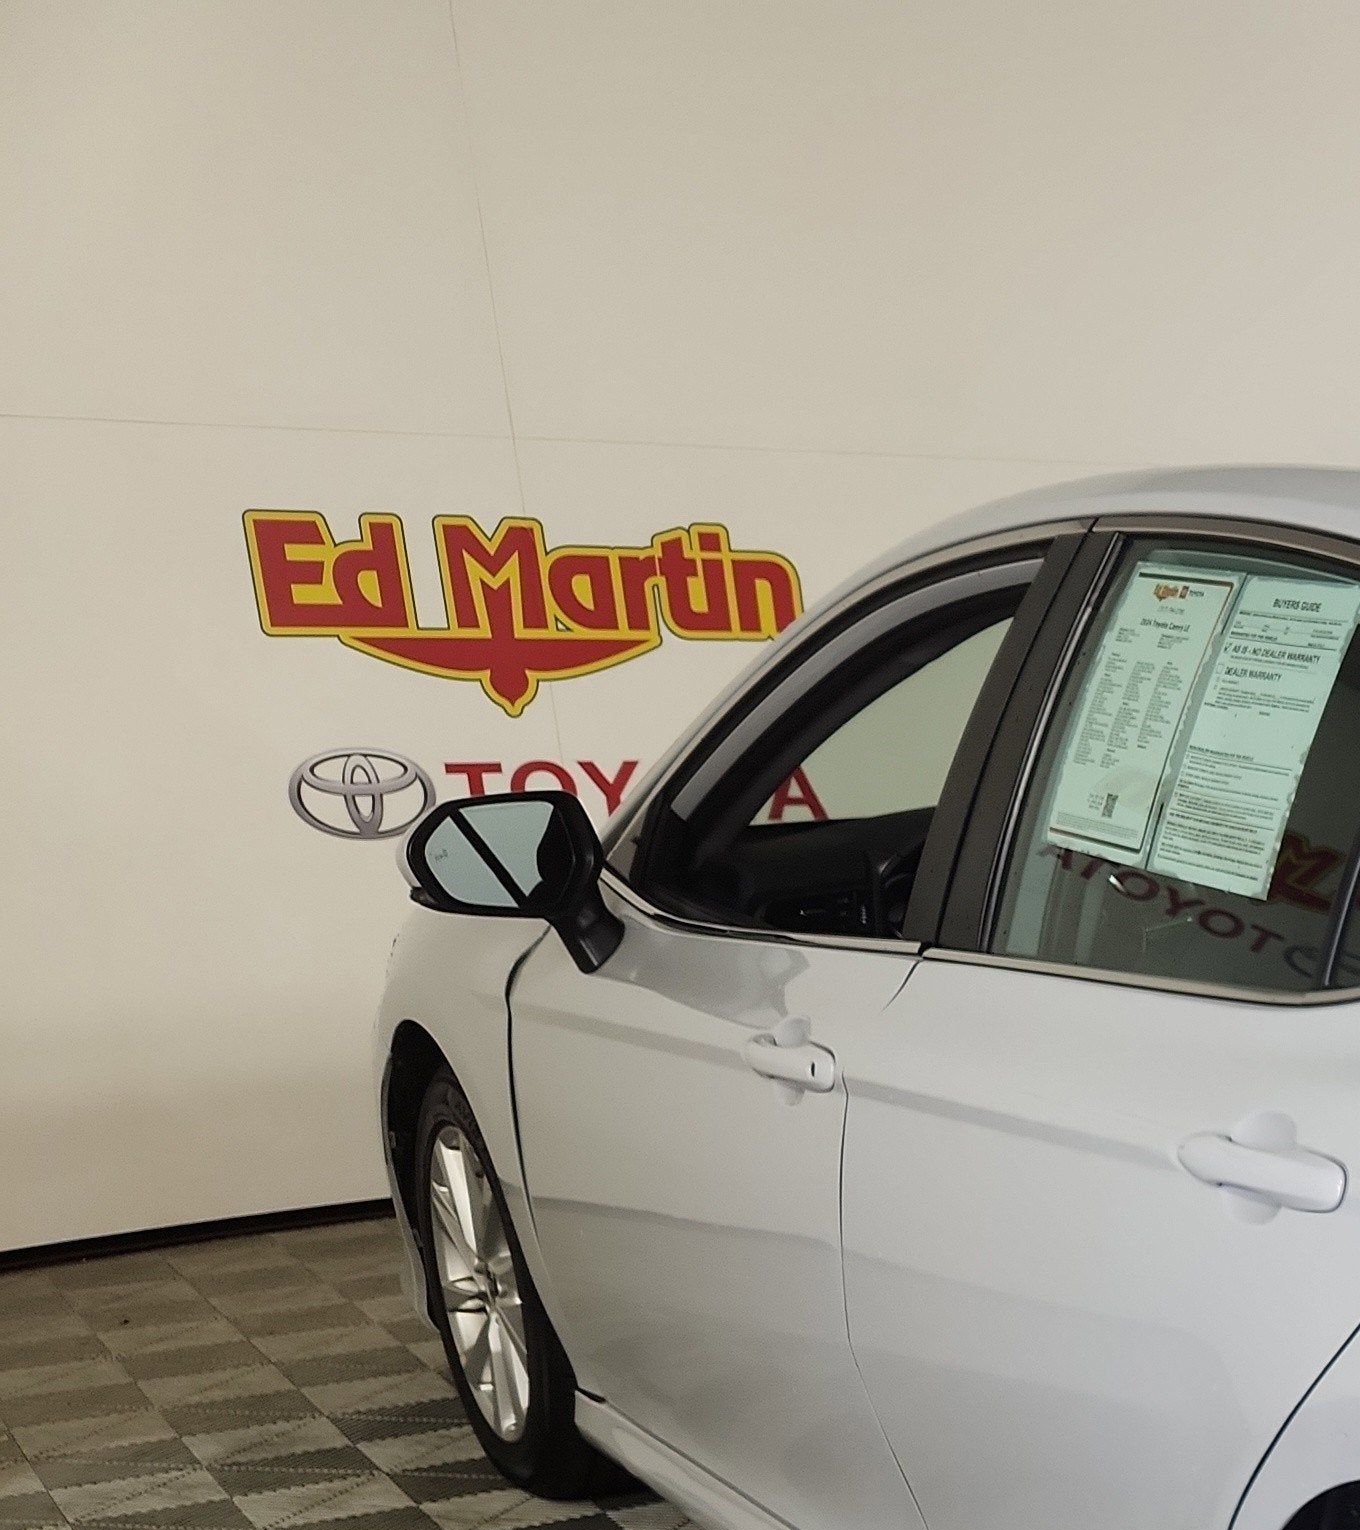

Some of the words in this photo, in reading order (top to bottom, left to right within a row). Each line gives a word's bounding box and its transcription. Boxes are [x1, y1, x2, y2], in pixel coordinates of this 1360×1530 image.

[243, 509, 417, 637] Ed
[433, 514, 804, 641] Martin
[445, 760, 830, 821] TOYA
